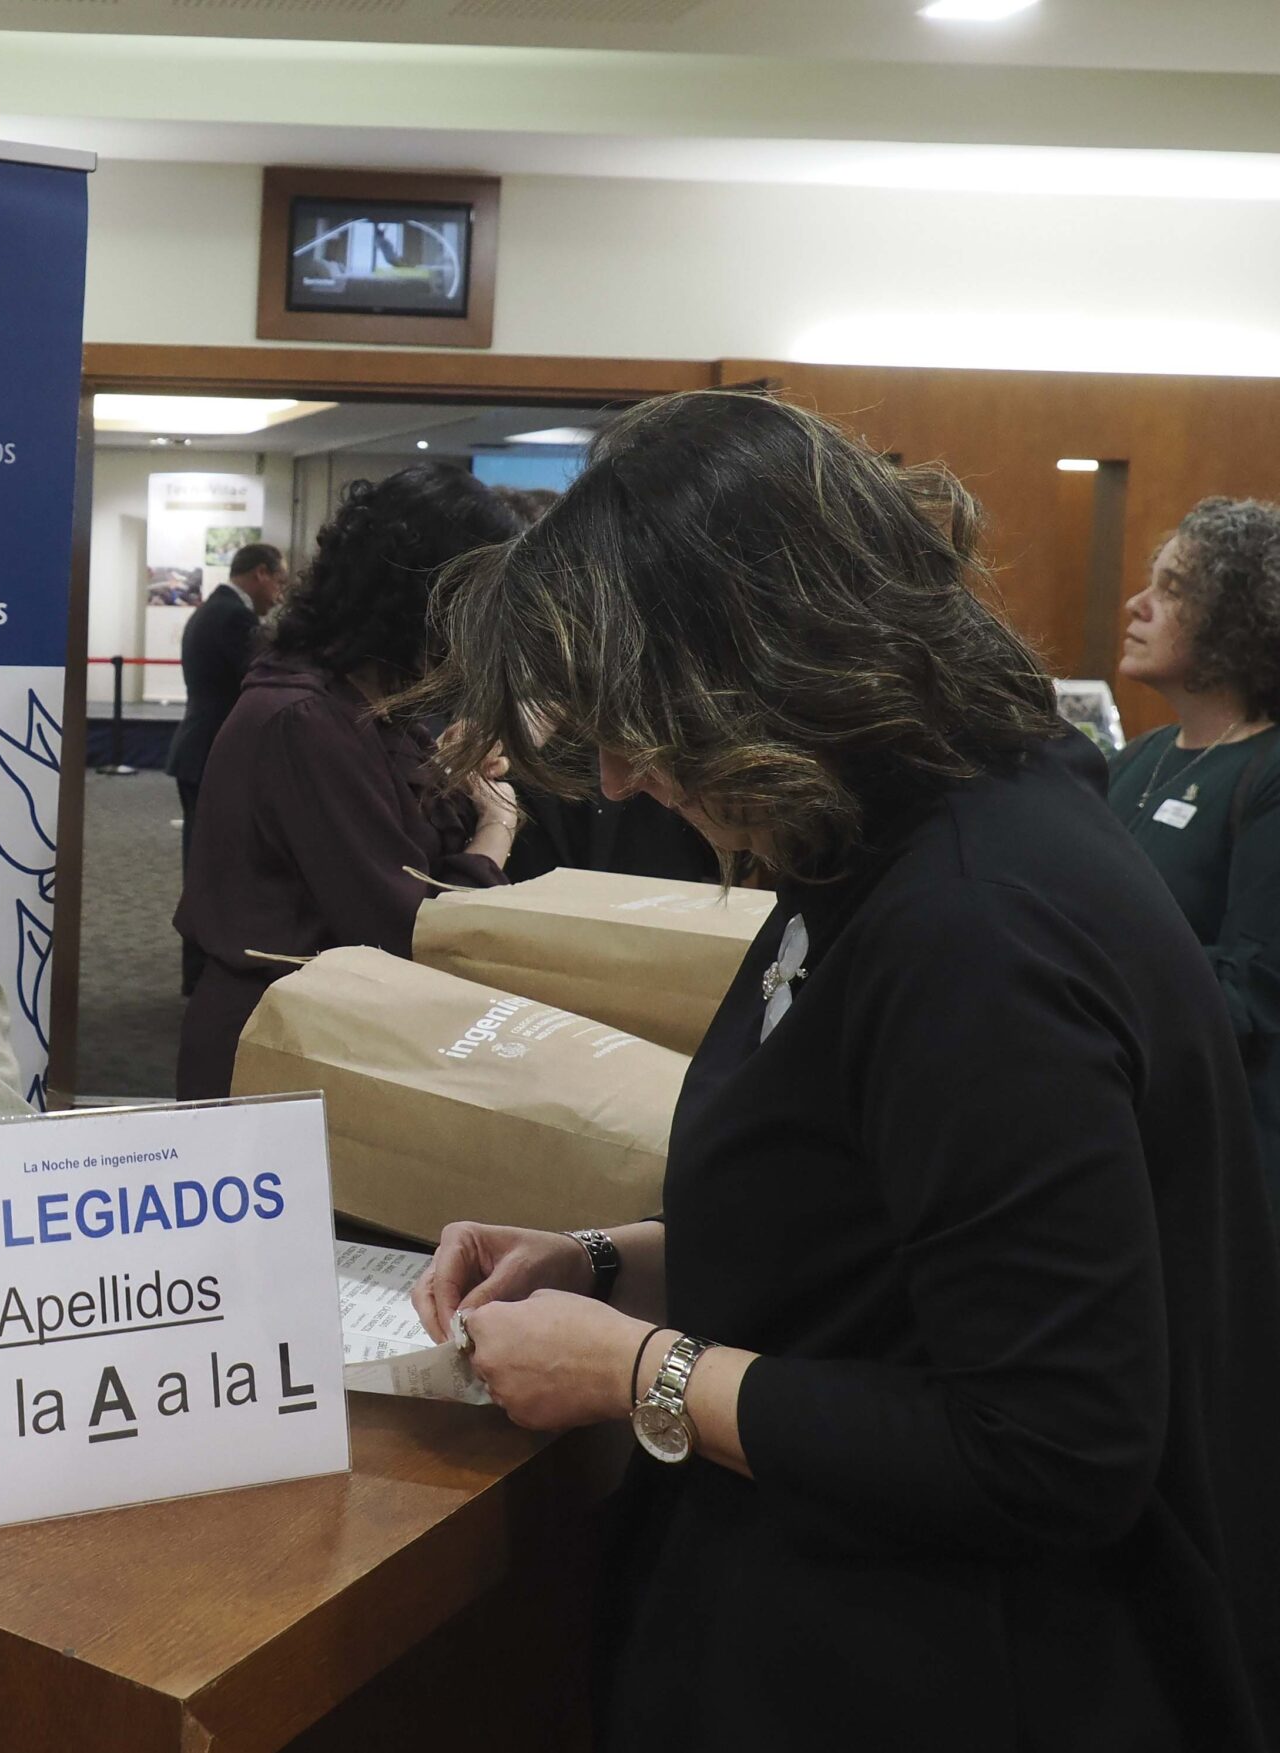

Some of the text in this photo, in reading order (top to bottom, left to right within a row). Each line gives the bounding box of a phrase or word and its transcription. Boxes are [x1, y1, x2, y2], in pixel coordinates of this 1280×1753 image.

[23, 1148, 179, 1173] La Noche de ingenierosVA
[16, 1378, 66, 1437] la
[88, 1366, 137, 1428] A
[157, 1371, 190, 1417] a
[210, 1351, 258, 1408] la
[278, 1342, 315, 1398] L
